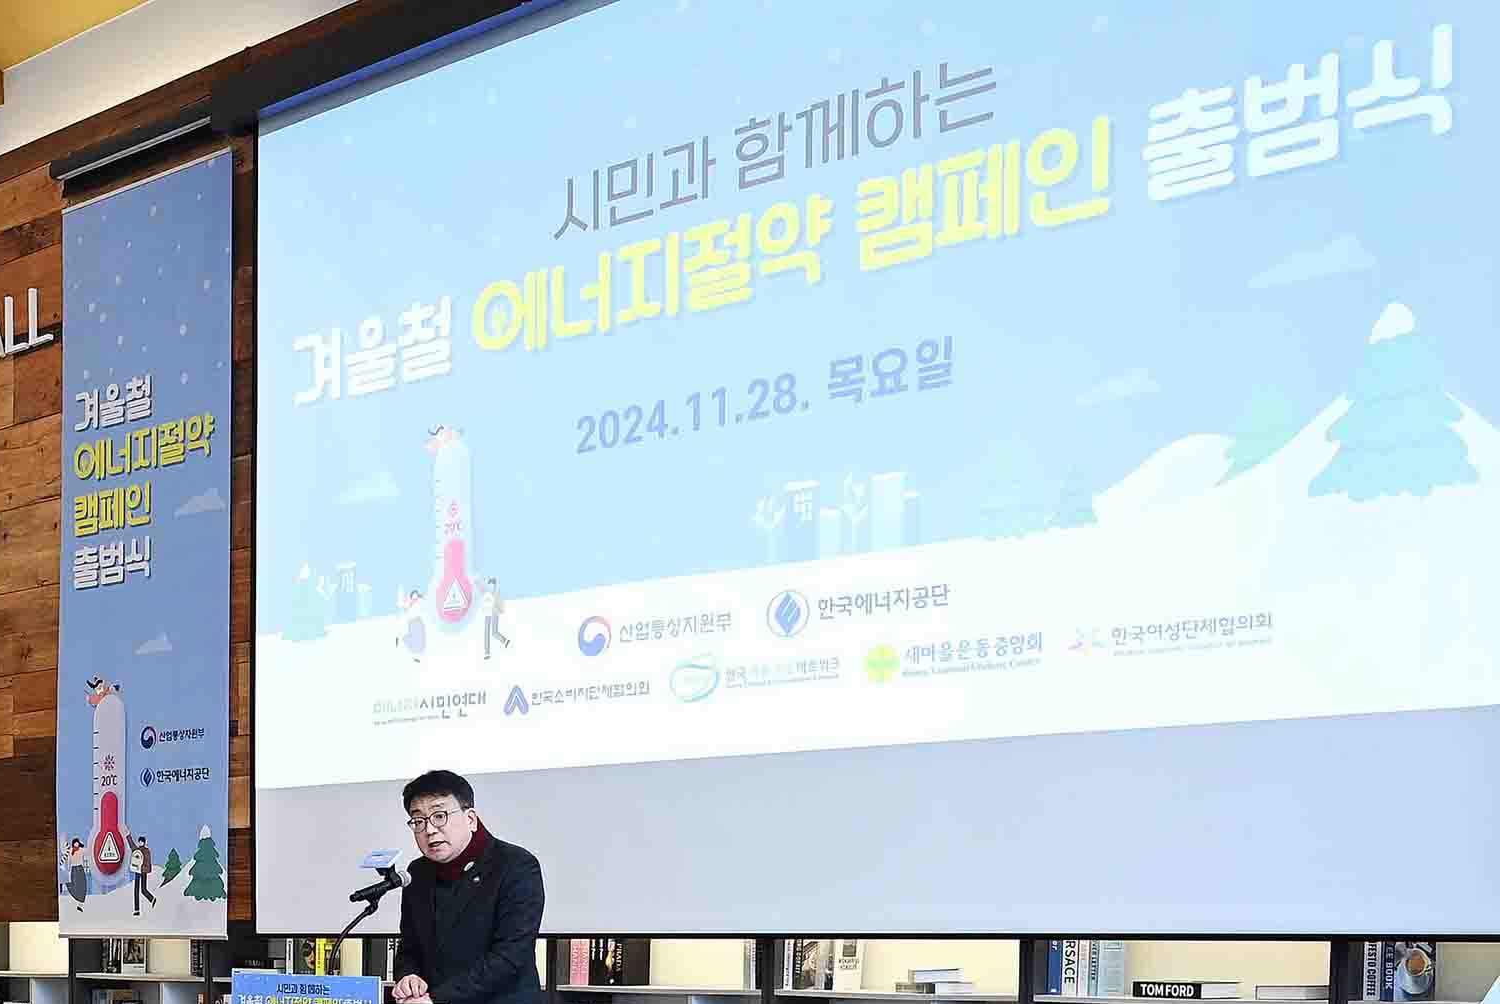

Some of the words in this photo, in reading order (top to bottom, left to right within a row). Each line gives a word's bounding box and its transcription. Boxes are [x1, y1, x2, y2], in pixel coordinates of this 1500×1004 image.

[553, 135, 717, 240] 시민과
[734, 62, 997, 190] 함께하는
[293, 296, 453, 406] 겨울철
[472, 193, 833, 352] 에너지절약
[855, 115, 1111, 272] 캠페인
[1142, 23, 1454, 201] 출범식
[73, 375, 154, 432] 겨울철
[576, 374, 810, 454] 2024.11.28.
[827, 335, 954, 406] 목요일
[73, 411, 215, 480] 에너지절약
[73, 480, 152, 538] 캠페인
[72, 536, 152, 590] 출범식
[817, 583, 951, 621] 한국에너지공단
[619, 611, 733, 643] 산업통상자원부
[1111, 612, 1273, 647] 한국여성단체협의회
[905, 631, 1043, 663] 새마을운동중앙회
[158, 728, 205, 743] 산업통상자원부
[156, 767, 210, 784] 한국에너지공단
[276, 983, 298, 994] 시민과
[299, 984, 330, 996] 함께하는
[1139, 983, 1164, 997] TOM
[1165, 984, 1195, 997] FORD
